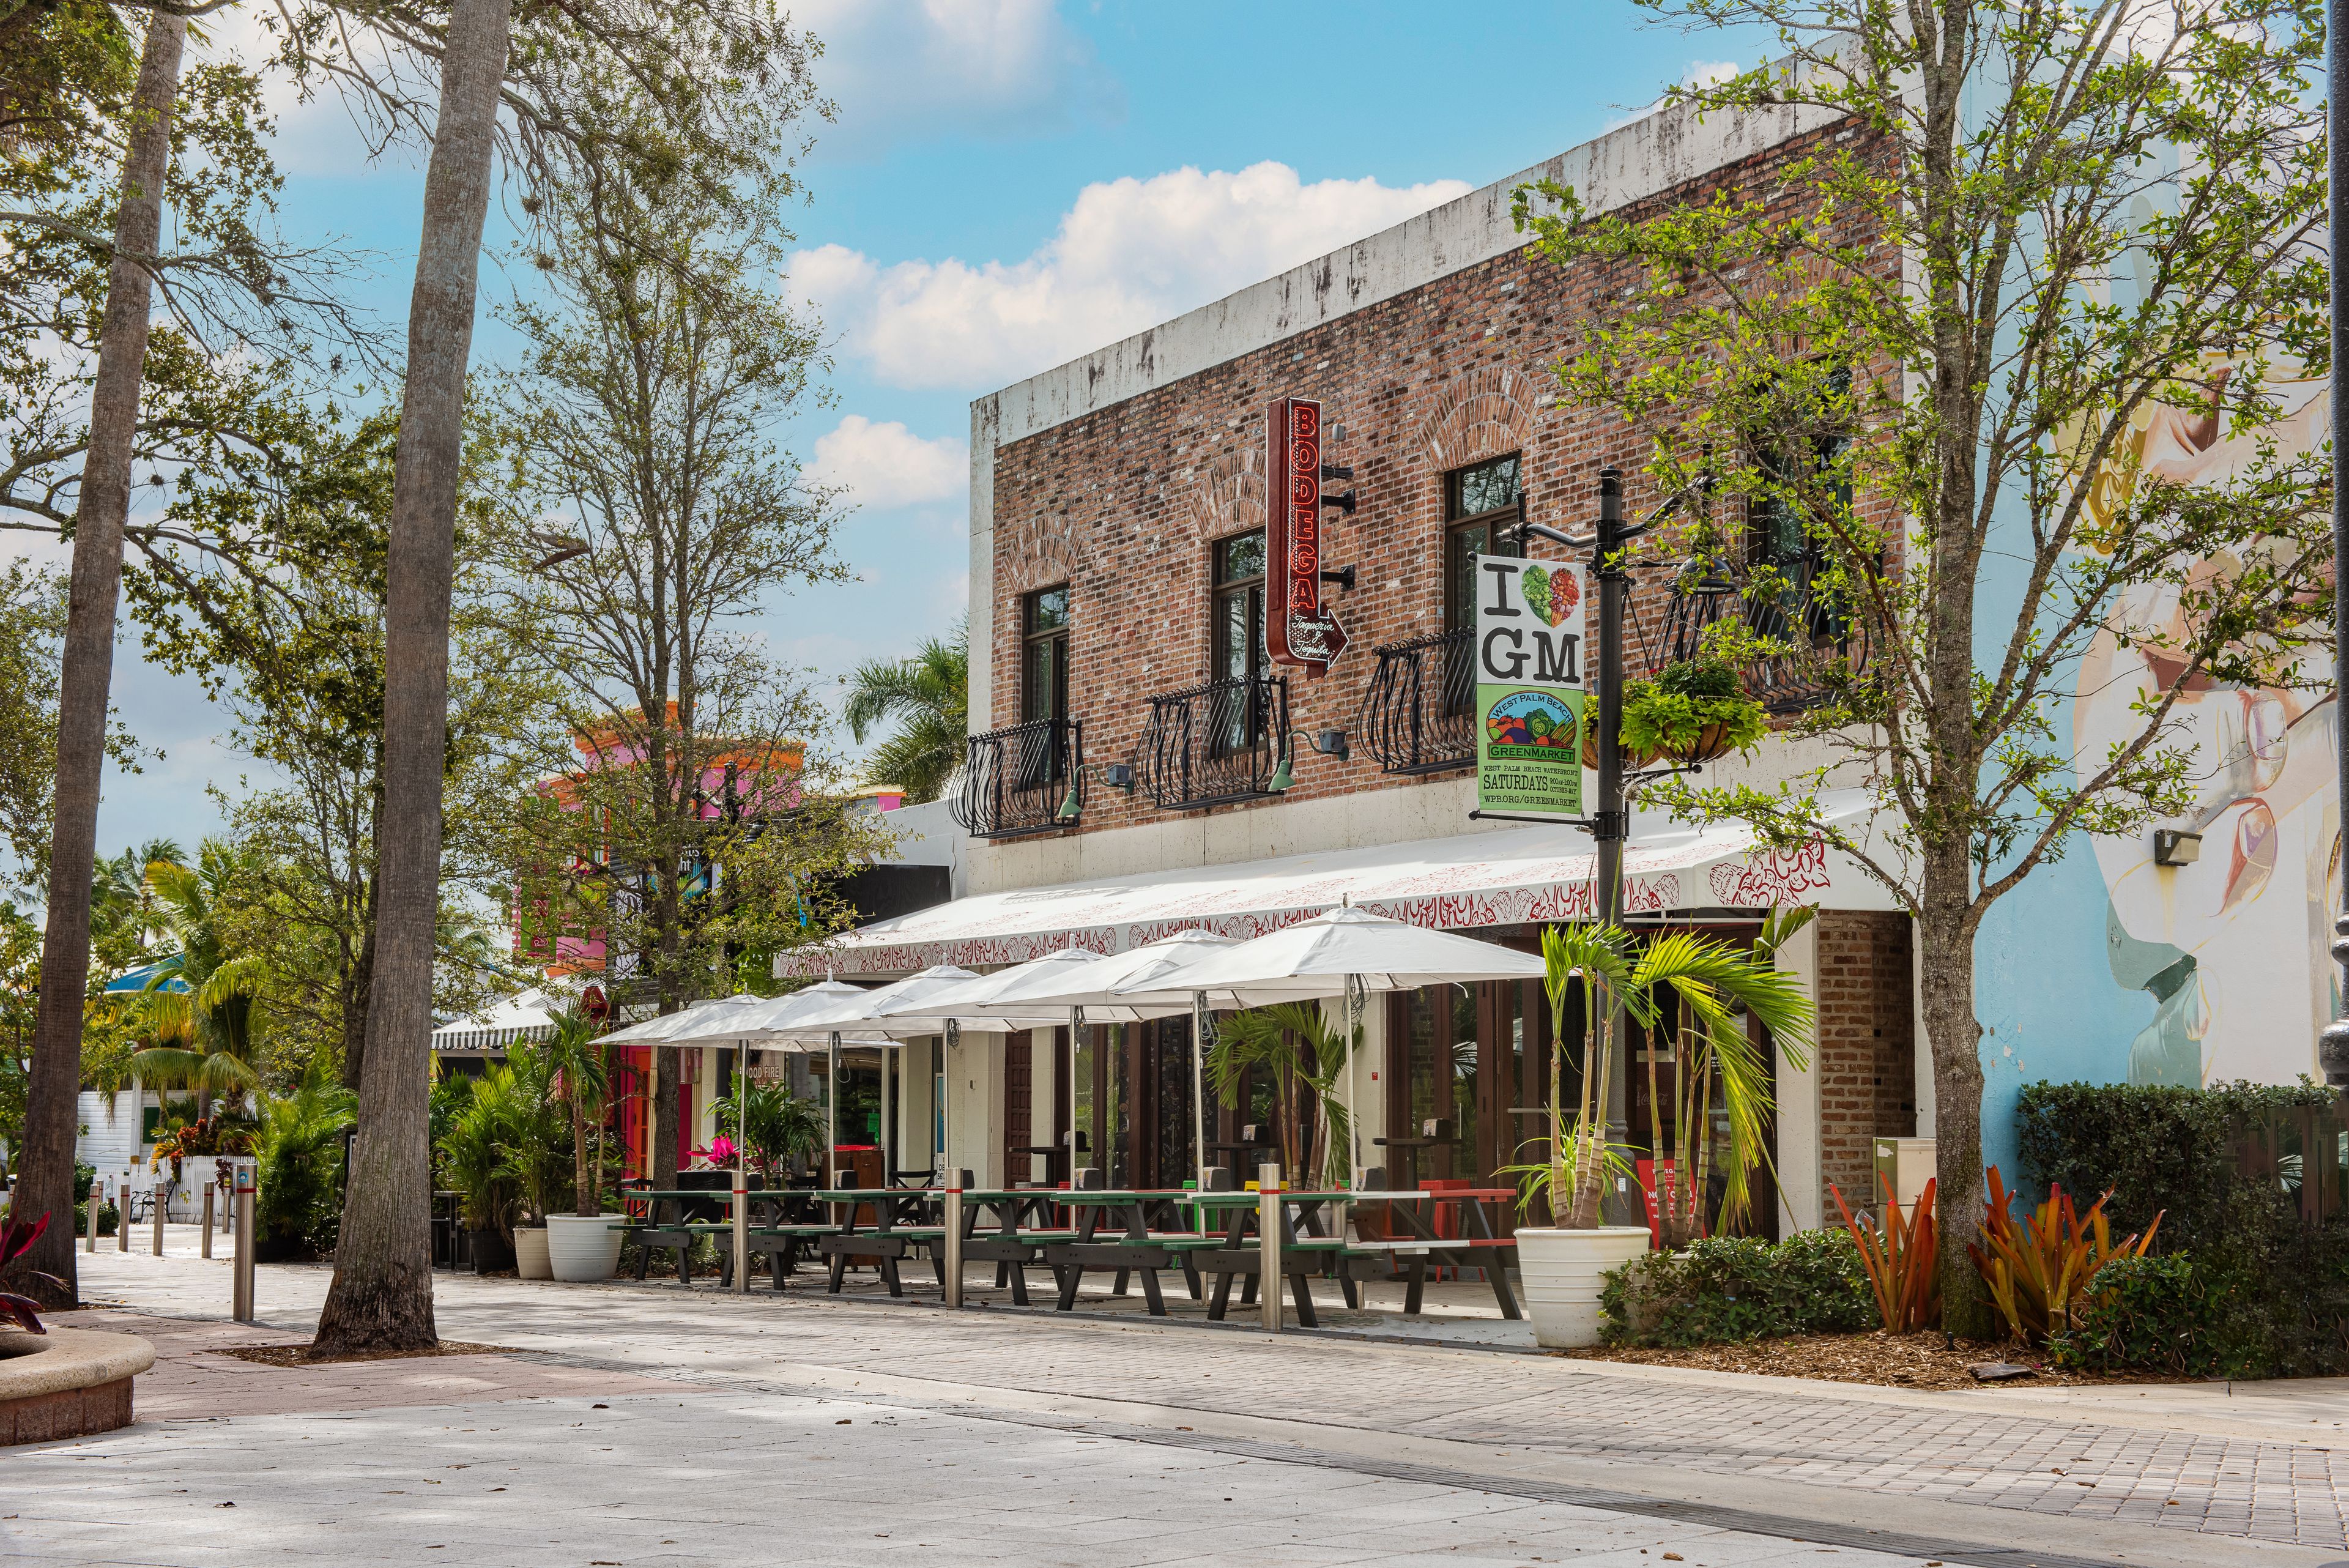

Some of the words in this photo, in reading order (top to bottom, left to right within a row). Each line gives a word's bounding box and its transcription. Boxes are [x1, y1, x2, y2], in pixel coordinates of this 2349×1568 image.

[1290, 406, 1318, 609] BODEGA
[1483, 562, 1523, 617] I
[1291, 615, 1335, 634] Taqueria
[1312, 631, 1324, 644] y
[1295, 641, 1330, 657] Tequila
[1482, 626, 1581, 684] GM
[1493, 697, 1518, 718] WEST
[1520, 694, 1545, 703] PALM
[1546, 697, 1573, 723] BEACH
[1490, 746, 1574, 760] GREENMARKET
[1543, 767, 1578, 776] WATERFRONT
[1483, 774, 1548, 791] SATURDAYS
[1549, 786, 1577, 795] OCTOBER-MAY
[1484, 795, 1577, 807] WPB.ORG/GREENMARKET
[764, 1066, 779, 1078] FIRE
